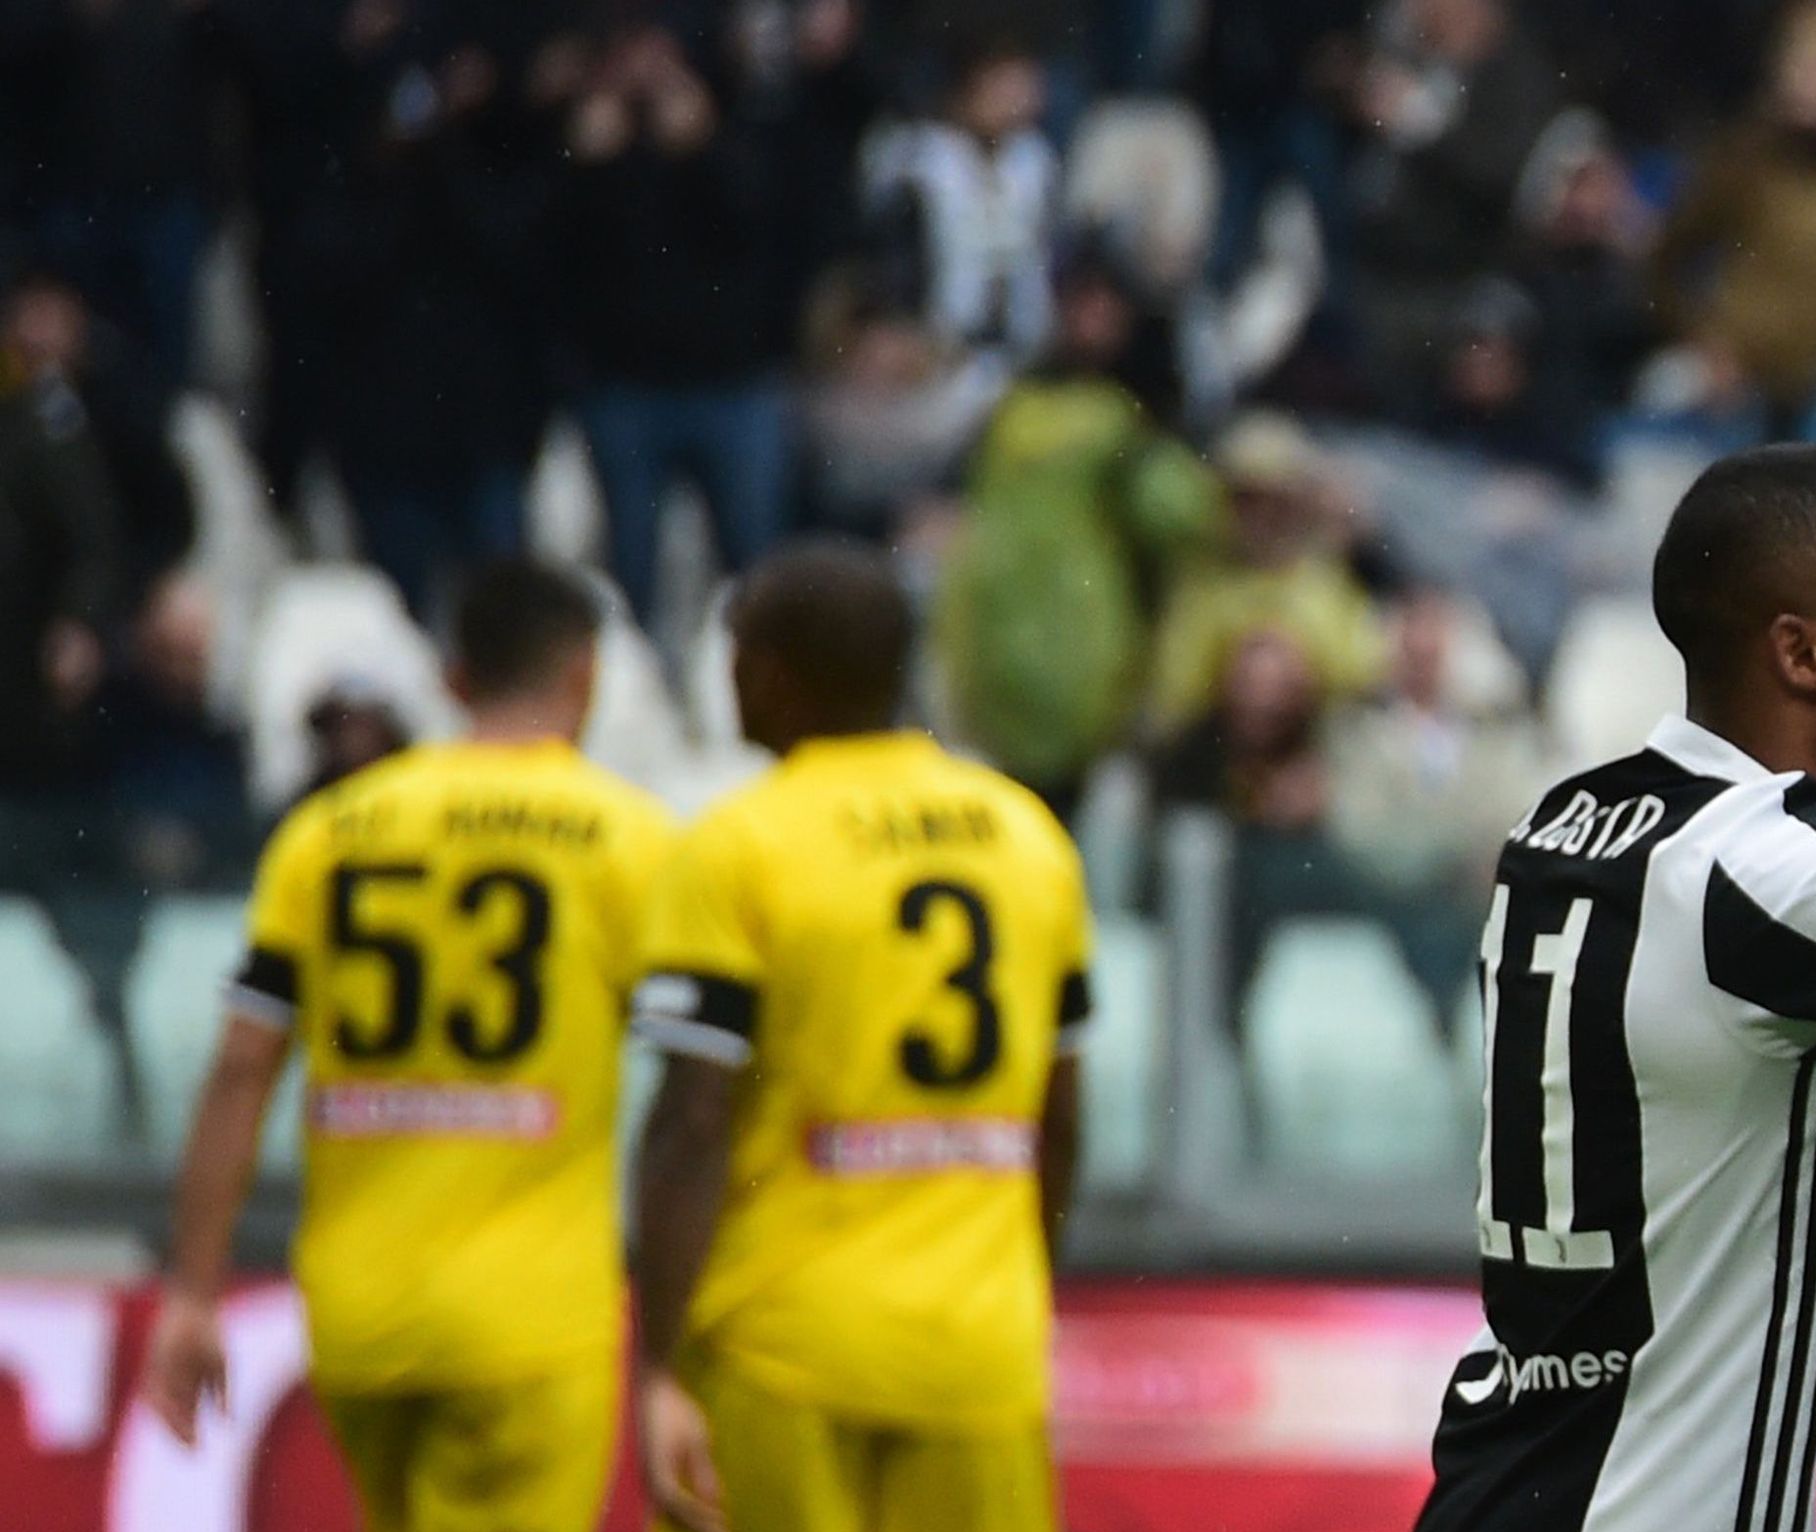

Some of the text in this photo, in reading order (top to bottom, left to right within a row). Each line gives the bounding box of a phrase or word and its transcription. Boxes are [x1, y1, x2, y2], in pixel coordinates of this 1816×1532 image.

[331, 862, 553, 1065] 53
[898, 879, 1001, 1091] 3
[1477, 883, 1615, 1271] 11
